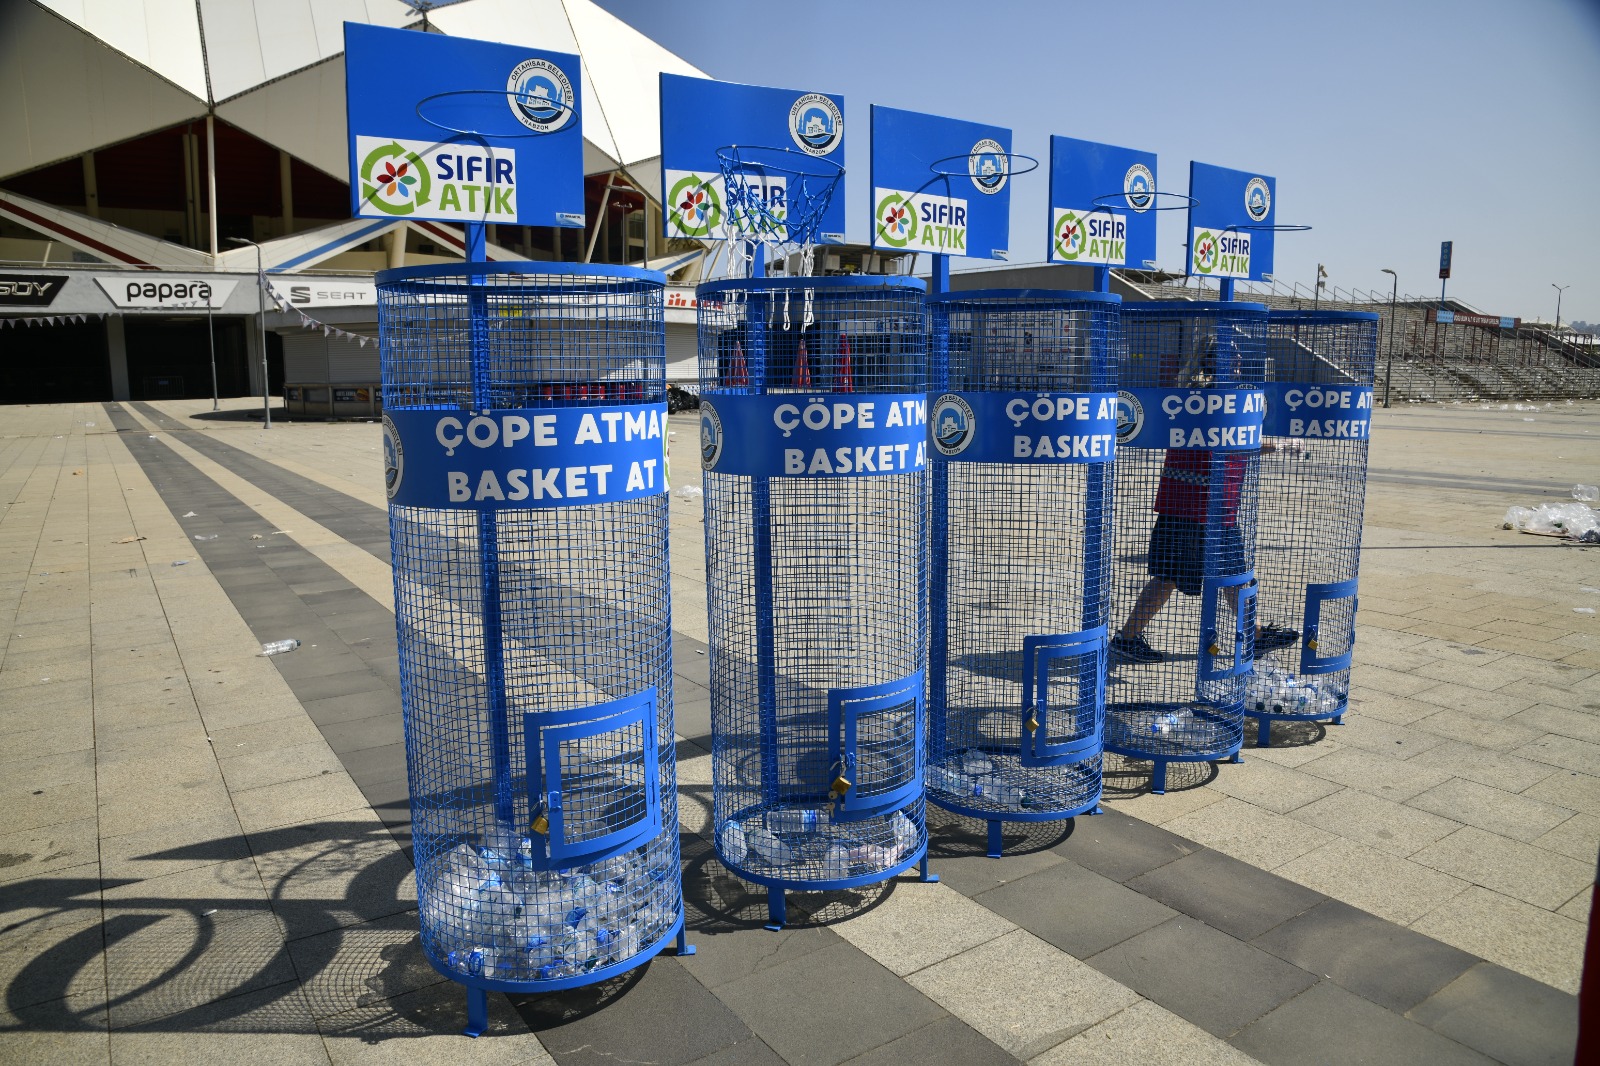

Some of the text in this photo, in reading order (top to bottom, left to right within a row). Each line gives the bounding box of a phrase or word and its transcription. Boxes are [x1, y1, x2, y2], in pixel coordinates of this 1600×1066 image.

[511, 59, 574, 103] ORTAHİSAR BELEDİYESİ
[521, 116, 549, 131] TRABZON
[435, 153, 515, 185] SIFIR
[438, 183, 515, 215] ATIK
[921, 201, 966, 227] SIFIR
[921, 224, 966, 250] ATIK
[1089, 219, 1125, 240] SIFIR
[1089, 238, 1125, 260] ATIK
[1220, 236, 1250, 256] SIFIR
[1220, 255, 1249, 274] ATIK
[127, 281, 212, 302] papara
[317, 291, 367, 301] SEAT
[1005, 393, 1090, 428] ÇÖPE
[1162, 391, 1237, 420] ÇÖPE
[1284, 386, 1351, 411] ÇÖPE
[773, 397, 927, 438] ÇÖPE ATM
[1289, 418, 1367, 437] BASKET
[435, 409, 661, 457] ÇÖPE ATMA
[1169, 425, 1256, 448] BASKET
[784, 443, 909, 475] BASKET
[1013, 435, 1111, 459] BASKET
[448, 459, 657, 502] BASKET AT
